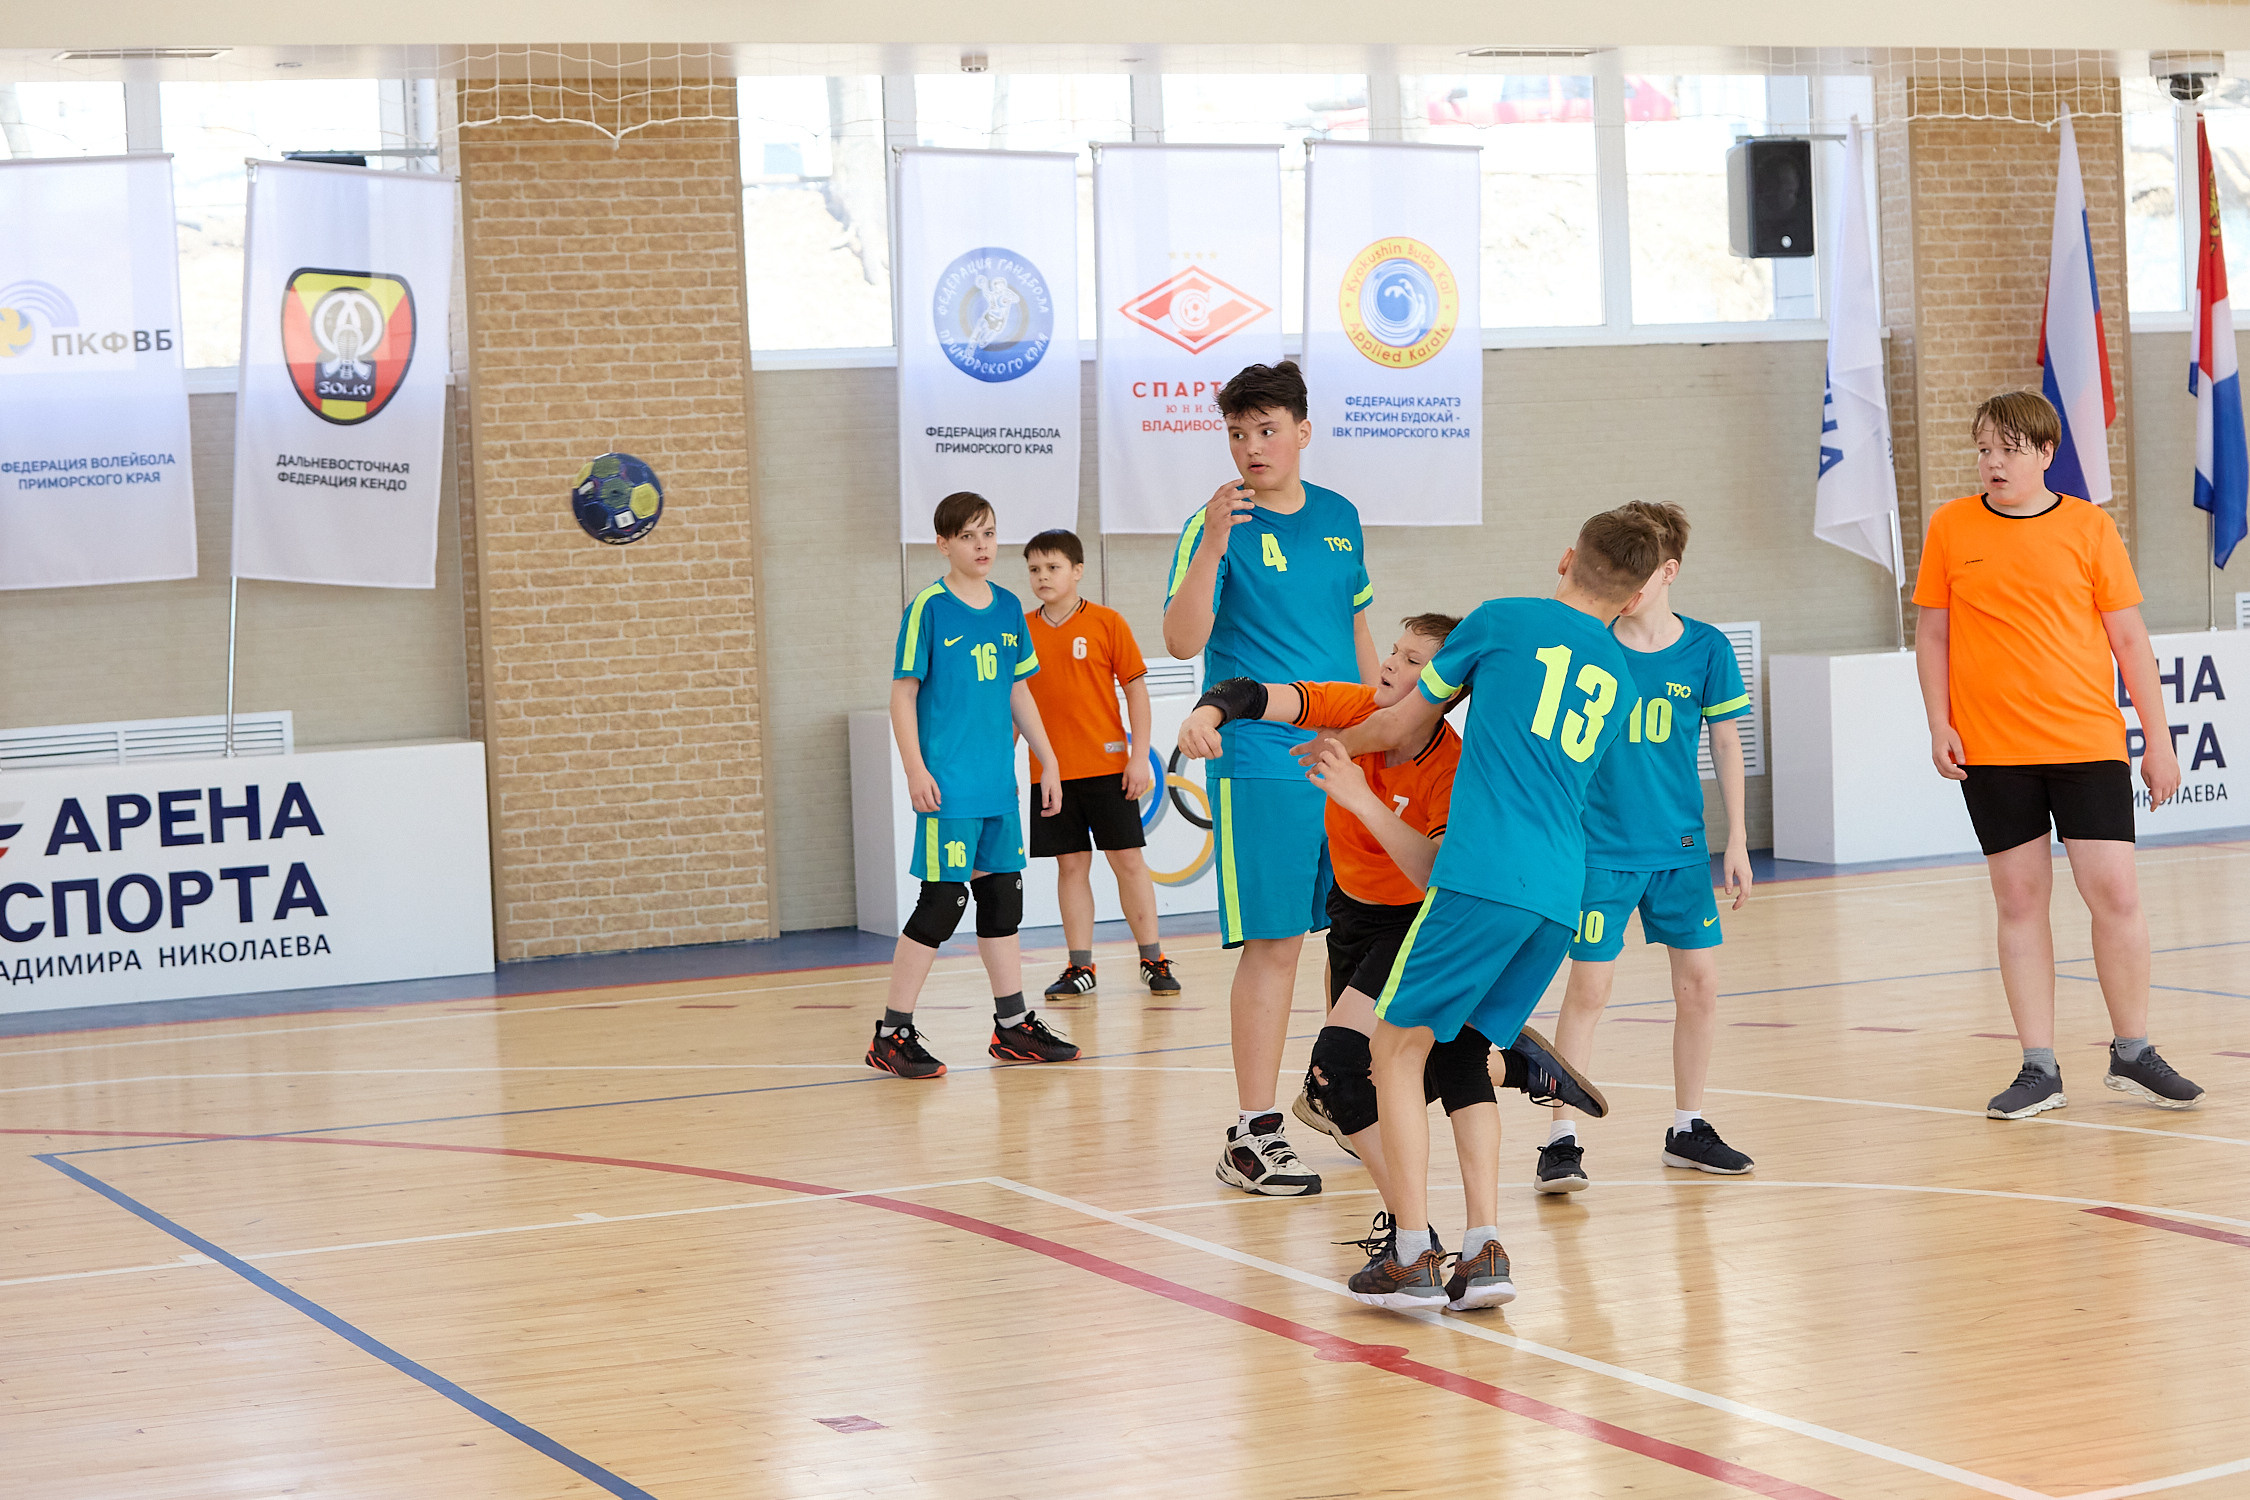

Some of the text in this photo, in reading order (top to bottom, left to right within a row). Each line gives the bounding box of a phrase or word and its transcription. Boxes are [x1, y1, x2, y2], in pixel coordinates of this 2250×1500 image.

[51, 328, 173, 356] ПКФВБ
[1132, 381, 1222, 398] СПАРТ
[1166, 404, 1216, 413] ЮНИО
[1345, 396, 1461, 408] ФЕДЕРАЦИЯ КАРАТЭ
[1142, 420, 1223, 433] ВЛАДИВОС
[1345, 411, 1399, 422] КЕКУСИН
[1401, 410, 1453, 423] БУДОКАЙ
[925, 426, 1061, 439] ФЕДЕРАЦИЯ ГАНДБОЛА
[1354, 427, 1438, 438] ПРИМОРСКОГО
[1441, 428, 1470, 438] КРАЯ
[935, 442, 1053, 454] ПРИМОРСКОГО КРАЯ
[1, 452, 176, 474] ФЕДЕРАЦИЯ ВОЛЕЙБОЛА
[276, 454, 410, 474] ДАЛЬНЕВОСТОЧНАЯ
[18, 471, 161, 490] ПРИМОРСКОГО КРАЯ
[277, 472, 407, 491] ФЕДЕРАЦИЯ КЕНДО
[1261, 533, 1287, 572] 4
[1072, 636, 1088, 660] 6
[970, 642, 998, 681] 16
[1665, 681, 1692, 698] T90
[1530, 643, 1618, 763] 13
[1629, 696, 1673, 743] 10
[45, 781, 325, 856] АРЕНА
[944, 840, 967, 868] 16
[0, 862, 330, 943] СПОРТА
[159, 934, 331, 968] НИКОЛАЕВА
